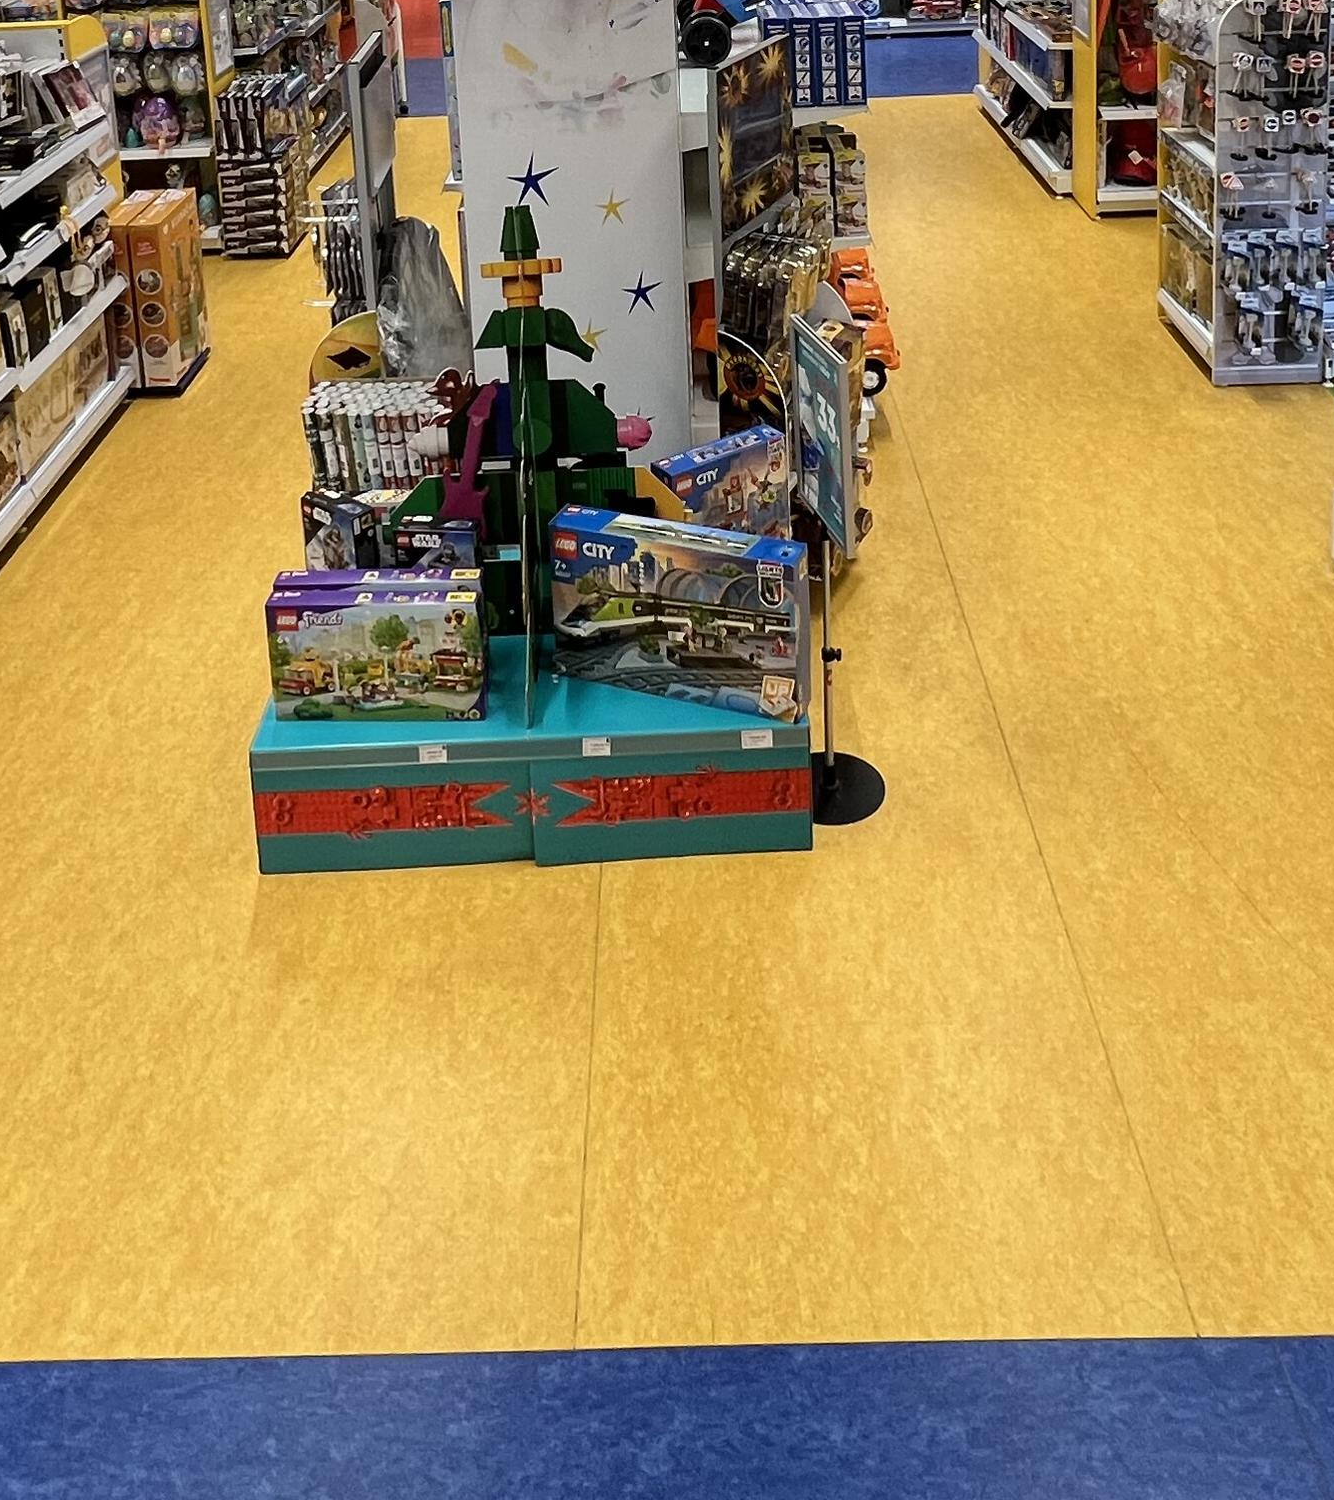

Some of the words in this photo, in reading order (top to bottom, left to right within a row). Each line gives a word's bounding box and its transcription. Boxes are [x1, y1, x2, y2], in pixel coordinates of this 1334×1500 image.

[696, 467, 719, 486] CITY
[554, 538, 577, 552] LEGO
[582, 541, 616, 561] CITY
[301, 610, 344, 628] Friends
